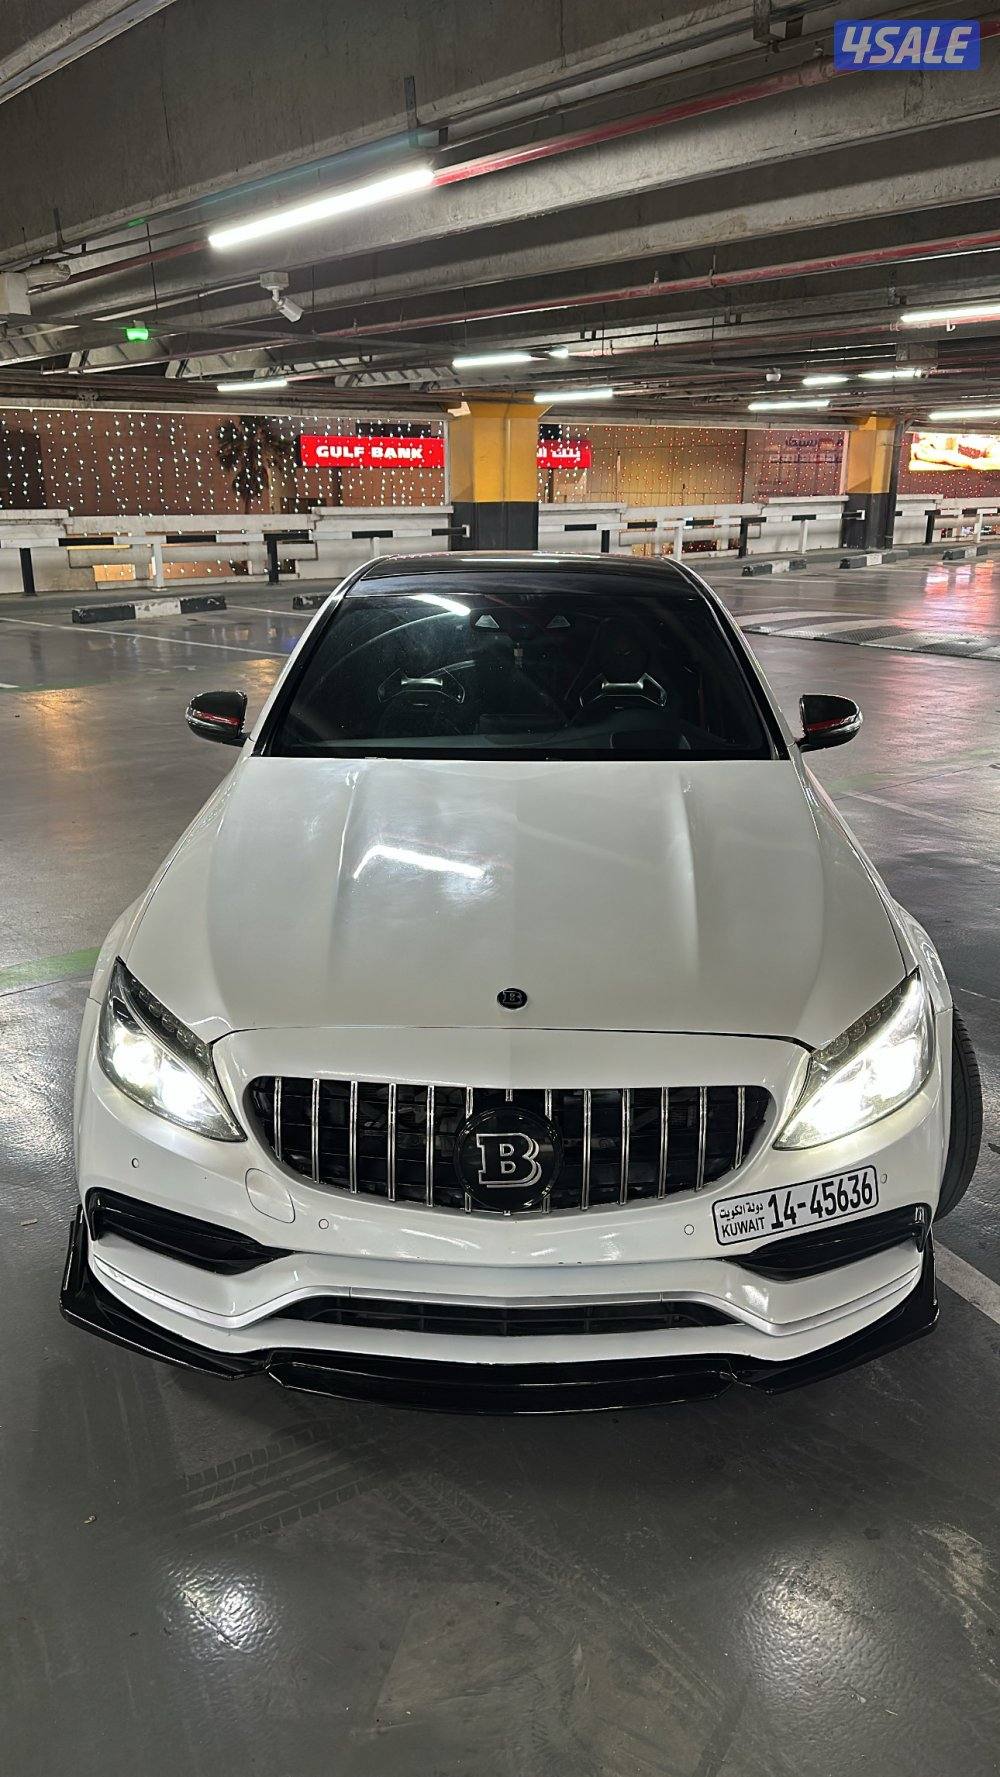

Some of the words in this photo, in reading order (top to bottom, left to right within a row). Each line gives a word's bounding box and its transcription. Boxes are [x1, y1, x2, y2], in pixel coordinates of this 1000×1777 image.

[315, 445, 365, 459] GULF
[371, 446, 423, 459] BANK
[476, 1132, 542, 1188] B
[745, 1201, 764, 1215] دولة
[767, 1171, 873, 1230] 14-45636
[719, 1204, 746, 1221] الكويت
[721, 1216, 765, 1238] KUWAIT
